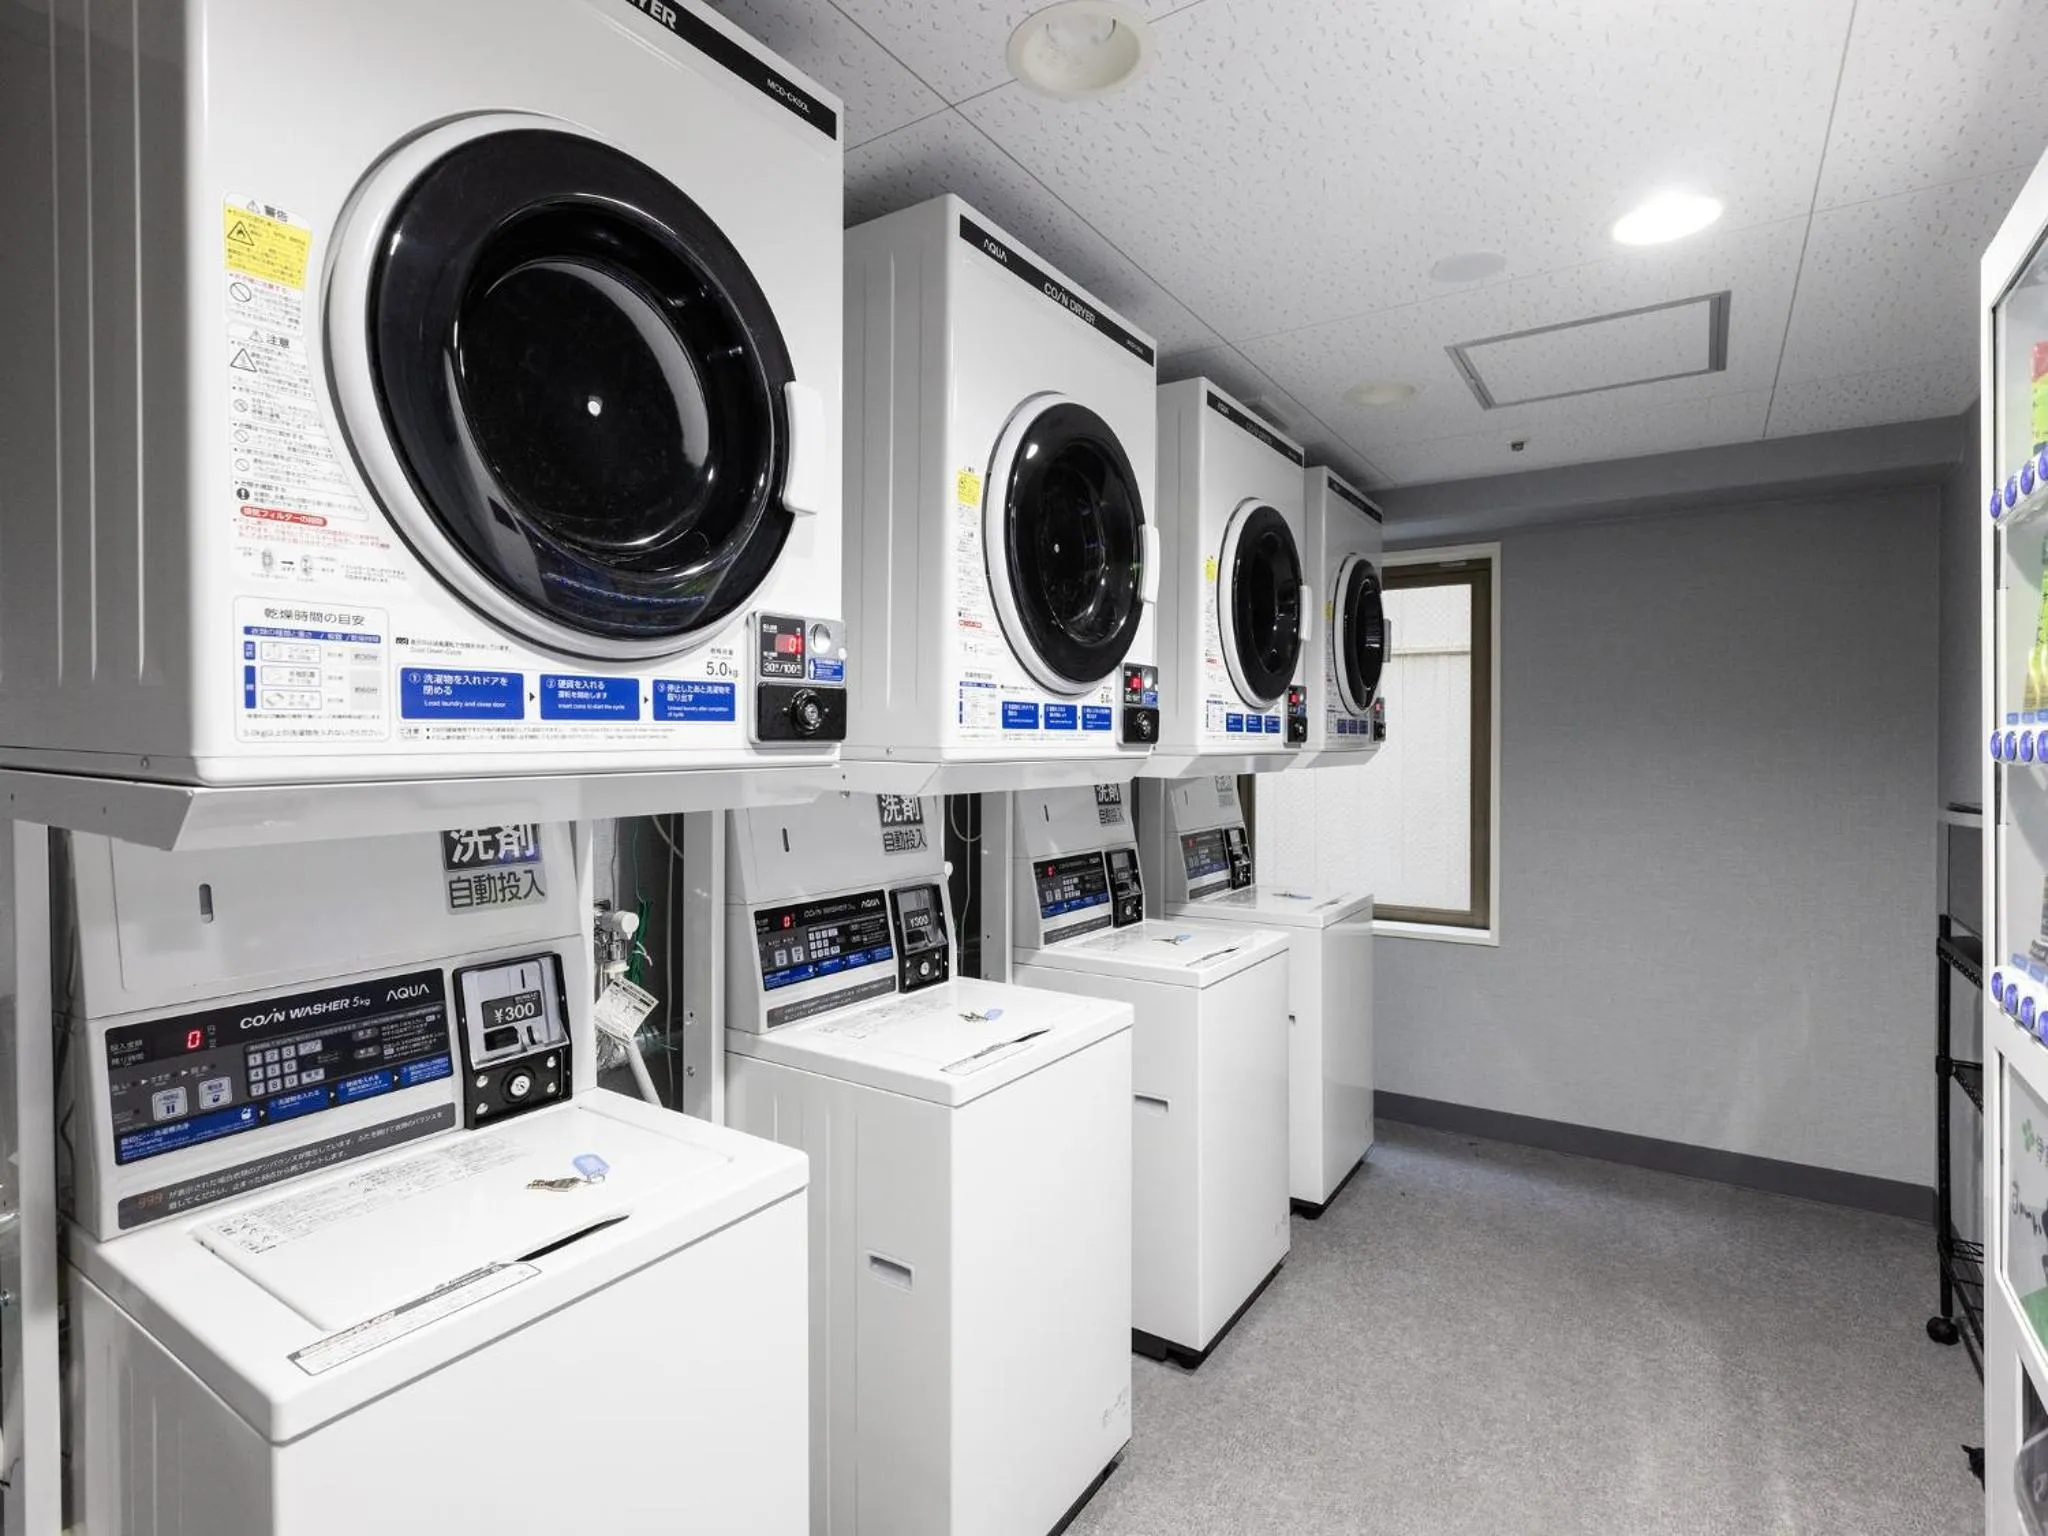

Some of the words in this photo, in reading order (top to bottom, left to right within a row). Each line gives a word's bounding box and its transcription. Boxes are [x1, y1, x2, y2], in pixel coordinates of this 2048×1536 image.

[984, 238, 1008, 263] AQUA
[1069, 300, 1096, 325] DRYER
[264, 608, 365, 626] 乾燥時間の目安
[423, 673, 509, 686] 洗濯物を入れドアを
[423, 685, 453, 696] 閉める
[441, 700, 462, 709] laundry
[881, 794, 920, 823] 洗剤
[450, 823, 535, 864] 洗剤
[883, 829, 927, 852] 自動投入
[449, 870, 545, 909] 自動投入
[289, 998, 350, 1020] WASHER
[351, 996, 371, 1007] 5kg
[386, 983, 430, 1002] AQUA
[494, 1002, 535, 1024] ¥300
[187, 1029, 201, 1049] 0
